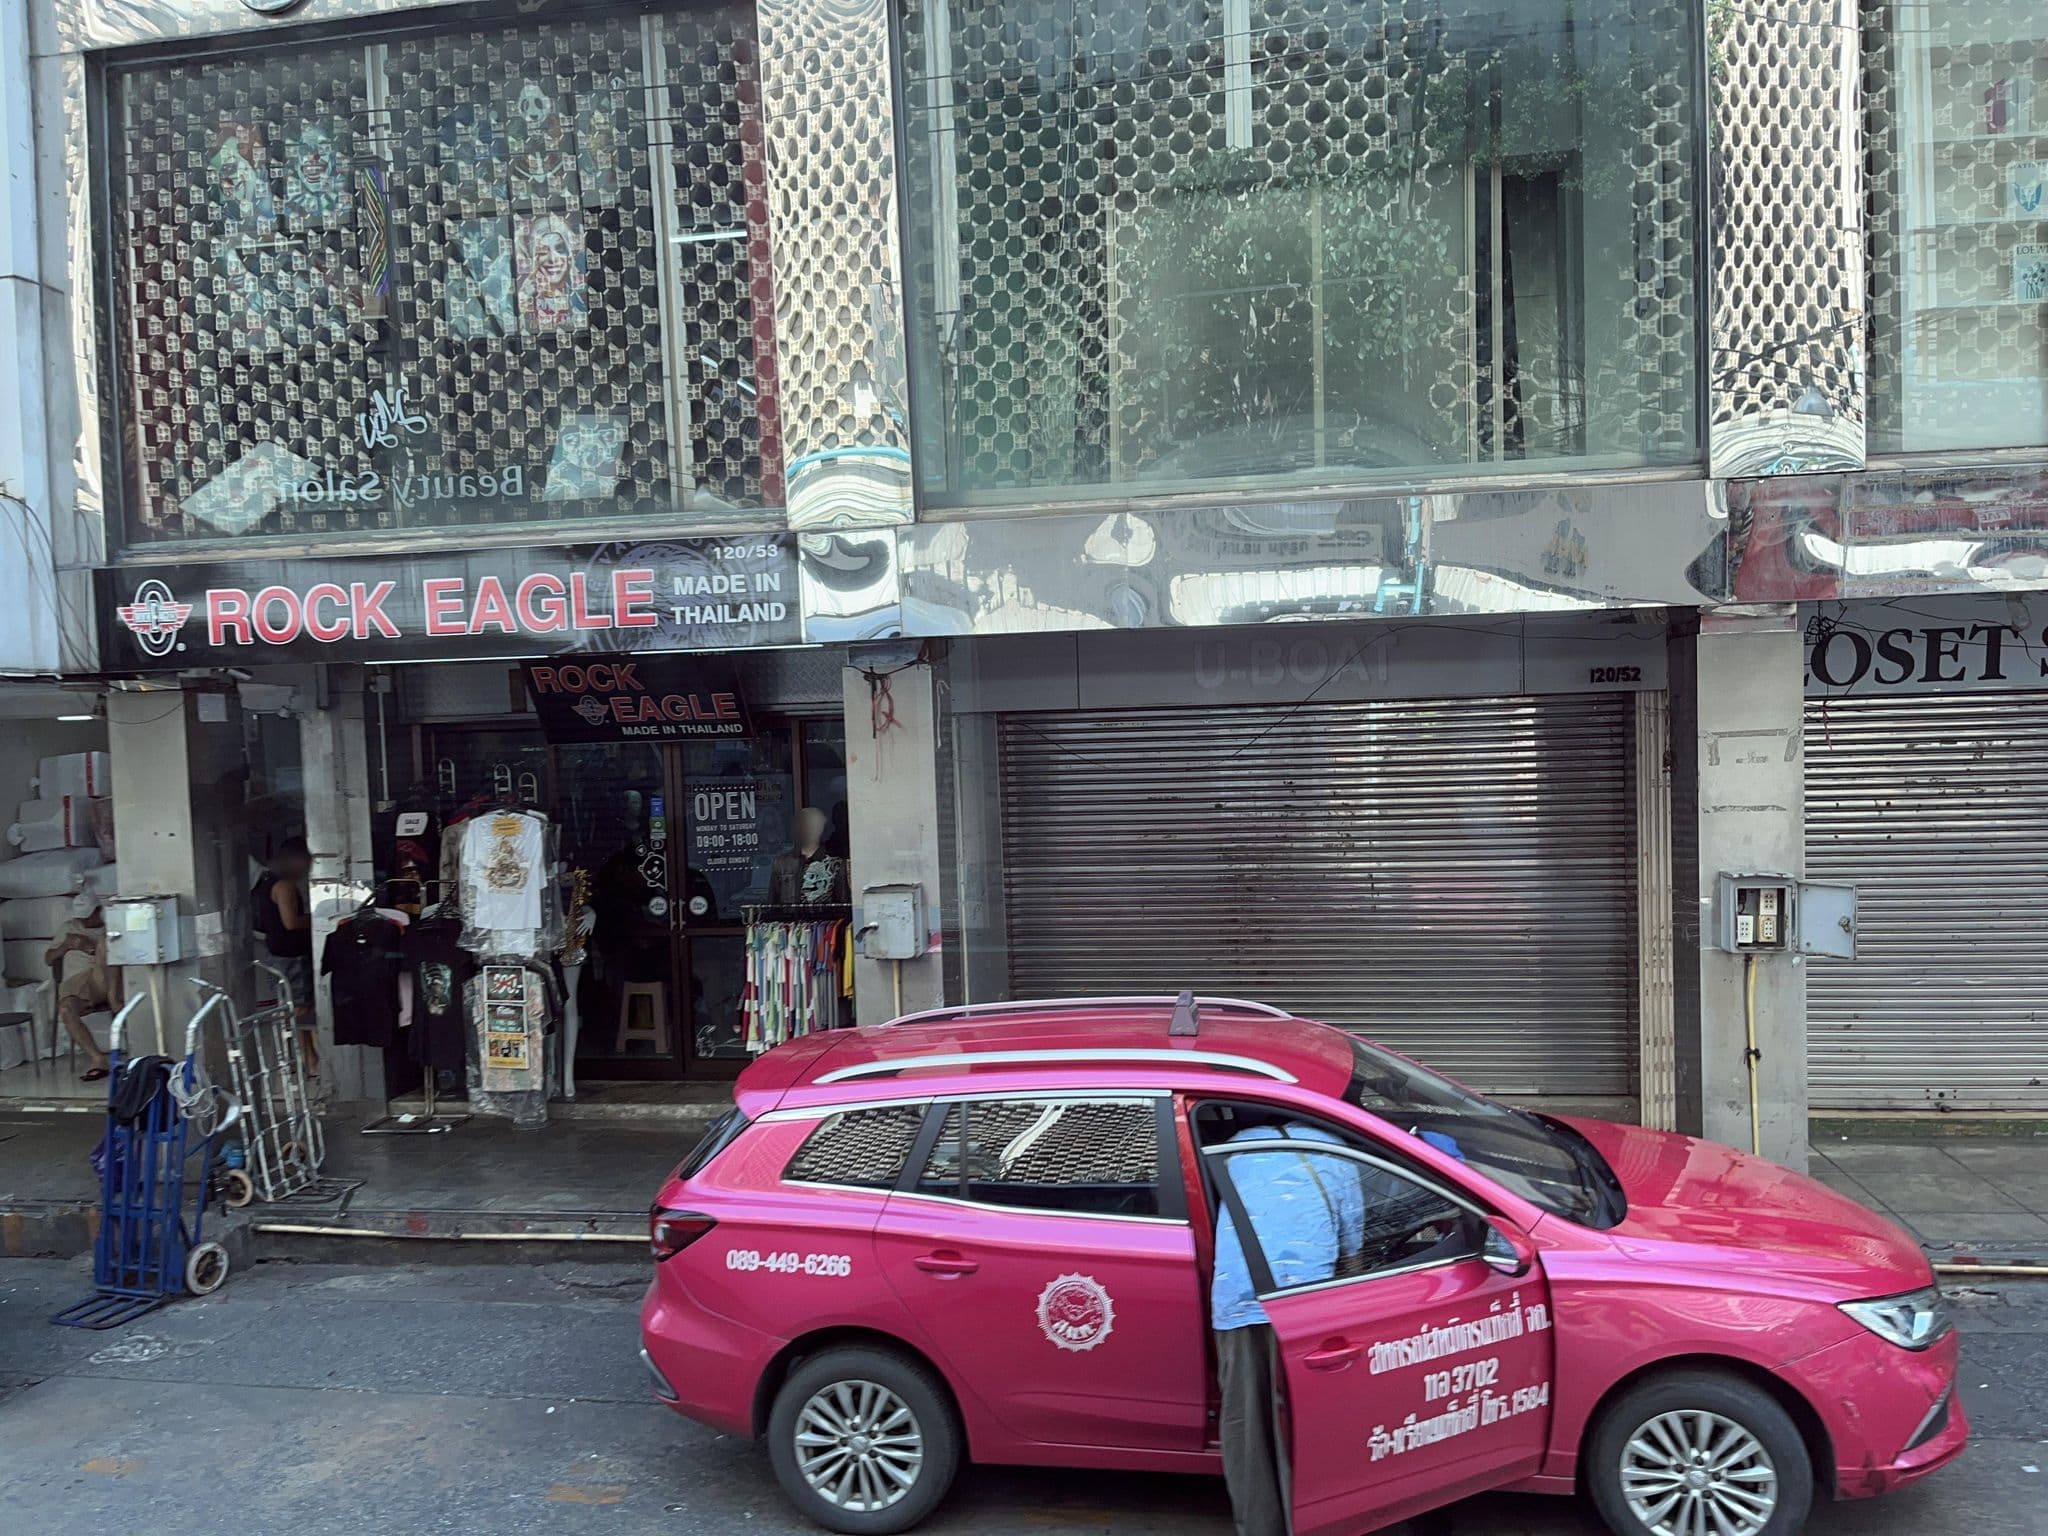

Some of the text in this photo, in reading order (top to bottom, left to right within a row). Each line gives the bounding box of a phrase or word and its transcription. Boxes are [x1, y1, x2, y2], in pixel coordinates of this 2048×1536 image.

[713, 544, 779, 560] 120/53
[673, 572, 781, 596] MADE IN
[205, 568, 658, 646] ROCK EAGLE
[670, 602, 786, 625] THAILAND
[1804, 624, 2020, 687] OSET
[530, 663, 645, 694] ROCK
[1590, 666, 1641, 682] 120/52
[609, 692, 740, 722] EAGLE
[622, 724, 743, 736] MADE IN THAILAND
[695, 791, 756, 820] OPEN
[729, 823, 756, 831] SATURDAY
[726, 1250, 851, 1276] 089-449-6266
[1452, 1357, 1499, 1395] 3702
